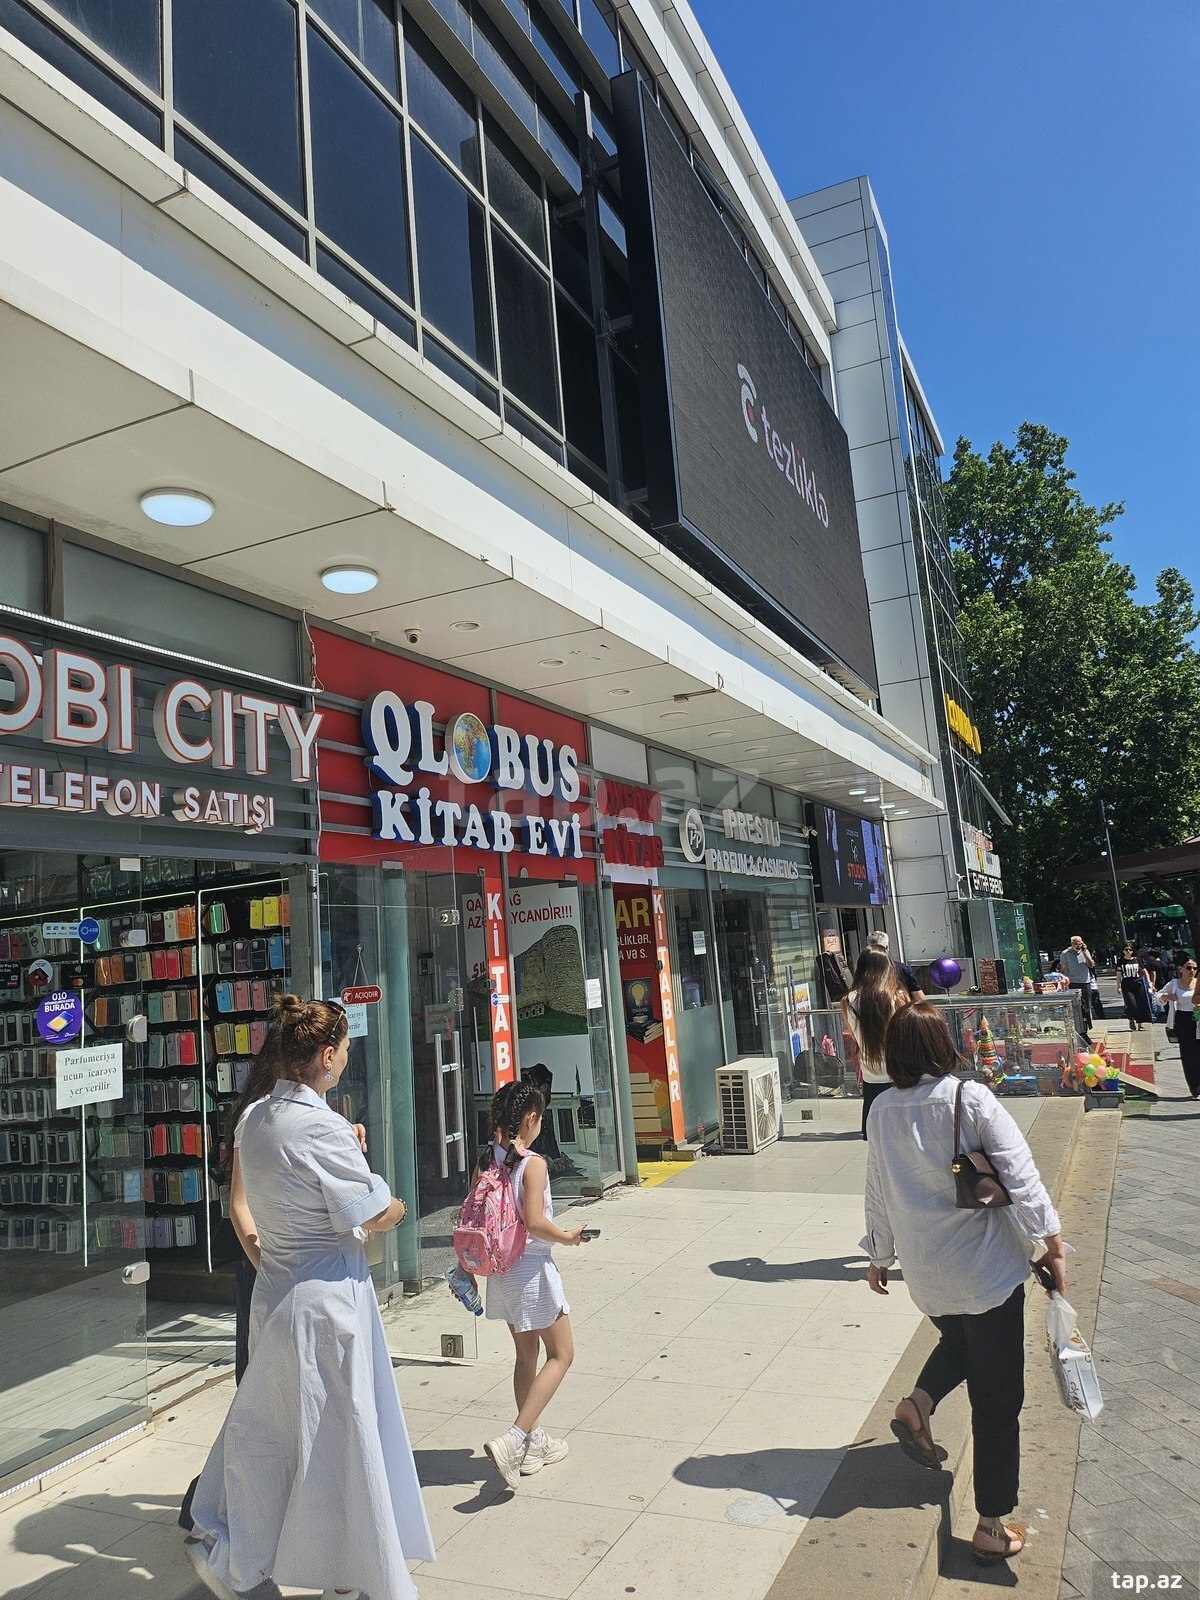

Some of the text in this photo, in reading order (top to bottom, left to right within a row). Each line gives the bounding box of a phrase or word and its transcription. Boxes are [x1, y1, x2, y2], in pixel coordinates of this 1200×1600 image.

[161, 680, 324, 781] CITY
[369, 690, 580, 803] QLOBUS
[0, 763, 274, 832] ELEFON SATIŞI
[377, 787, 584, 859] KİTAB EVİ
[756, 855, 799, 880] COSMETICS
[44, 1003, 75, 1013] BURADA
[51, 992, 67, 1001] 010
[354, 990, 379, 1000] AÇIQDIR
[487, 892, 512, 1082] KİTAB
[653, 893, 681, 1102] KİTABLAR
[69, 1081, 111, 1098] yer verilir
[88, 1067, 117, 1079] icarəyə
